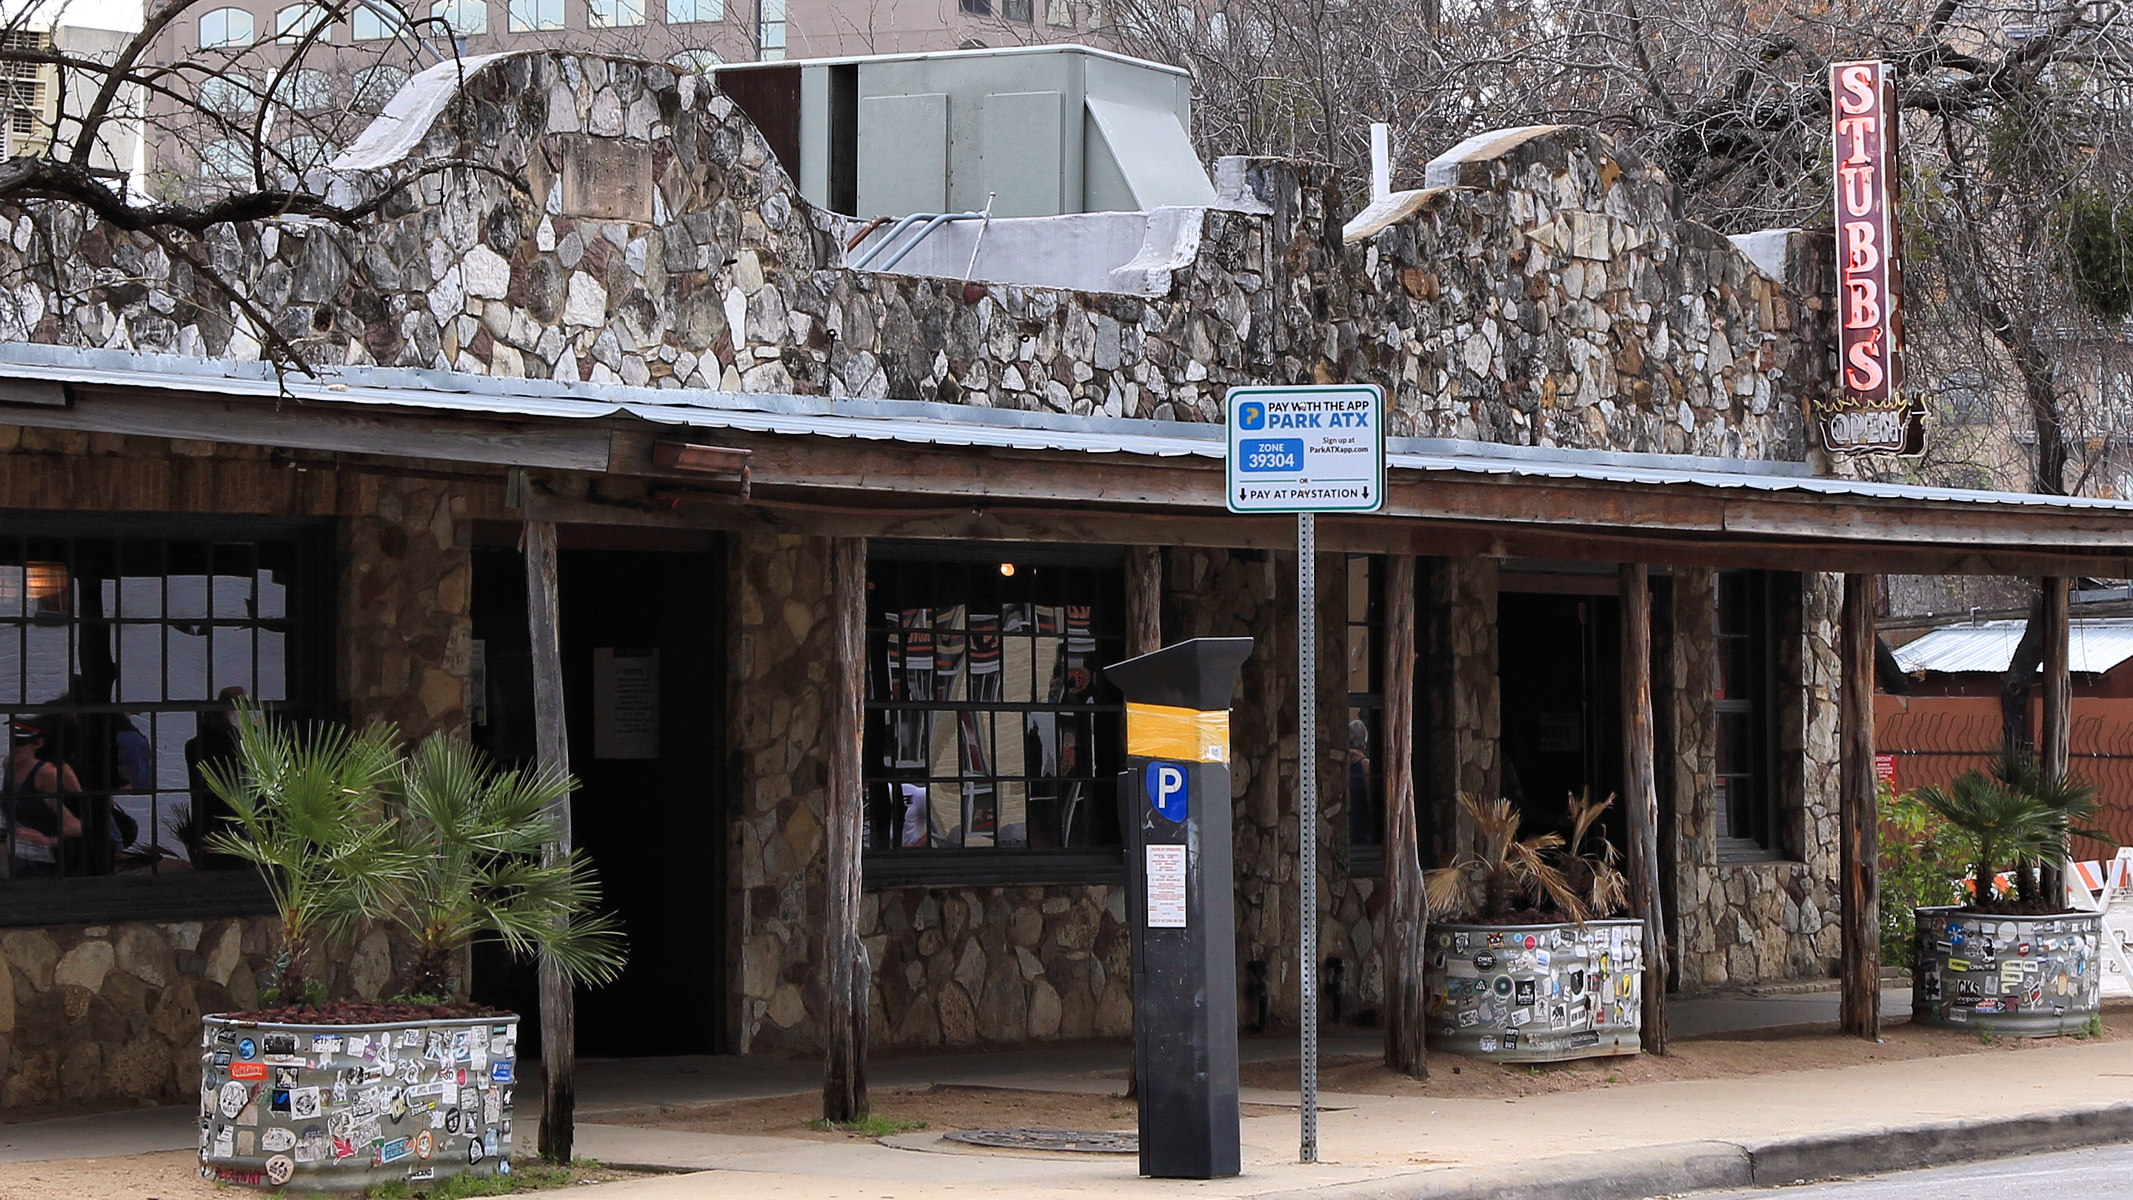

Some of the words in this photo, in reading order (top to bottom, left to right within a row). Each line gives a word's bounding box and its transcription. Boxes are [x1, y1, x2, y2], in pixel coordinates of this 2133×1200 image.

[1839, 66, 1884, 391] STUBB'S
[1268, 402, 1289, 412] PAY
[1291, 401, 1321, 412] WTH
[1323, 401, 1345, 411] THE
[1346, 400, 1369, 411] APP
[1268, 413, 1322, 429] PARK
[1328, 412, 1369, 428] ATX
[1831, 411, 1899, 444] OPEN
[1322, 436, 1337, 445] Sign
[1258, 443, 1285, 452] ZONE
[1309, 446, 1369, 454] ParkATXapp.com
[1249, 453, 1295, 468] 39304
[1250, 490, 1270, 499] PAY
[1273, 490, 1287, 499] AT
[1290, 488, 1358, 498] PAYSTATION
[1158, 767, 1183, 809] P
